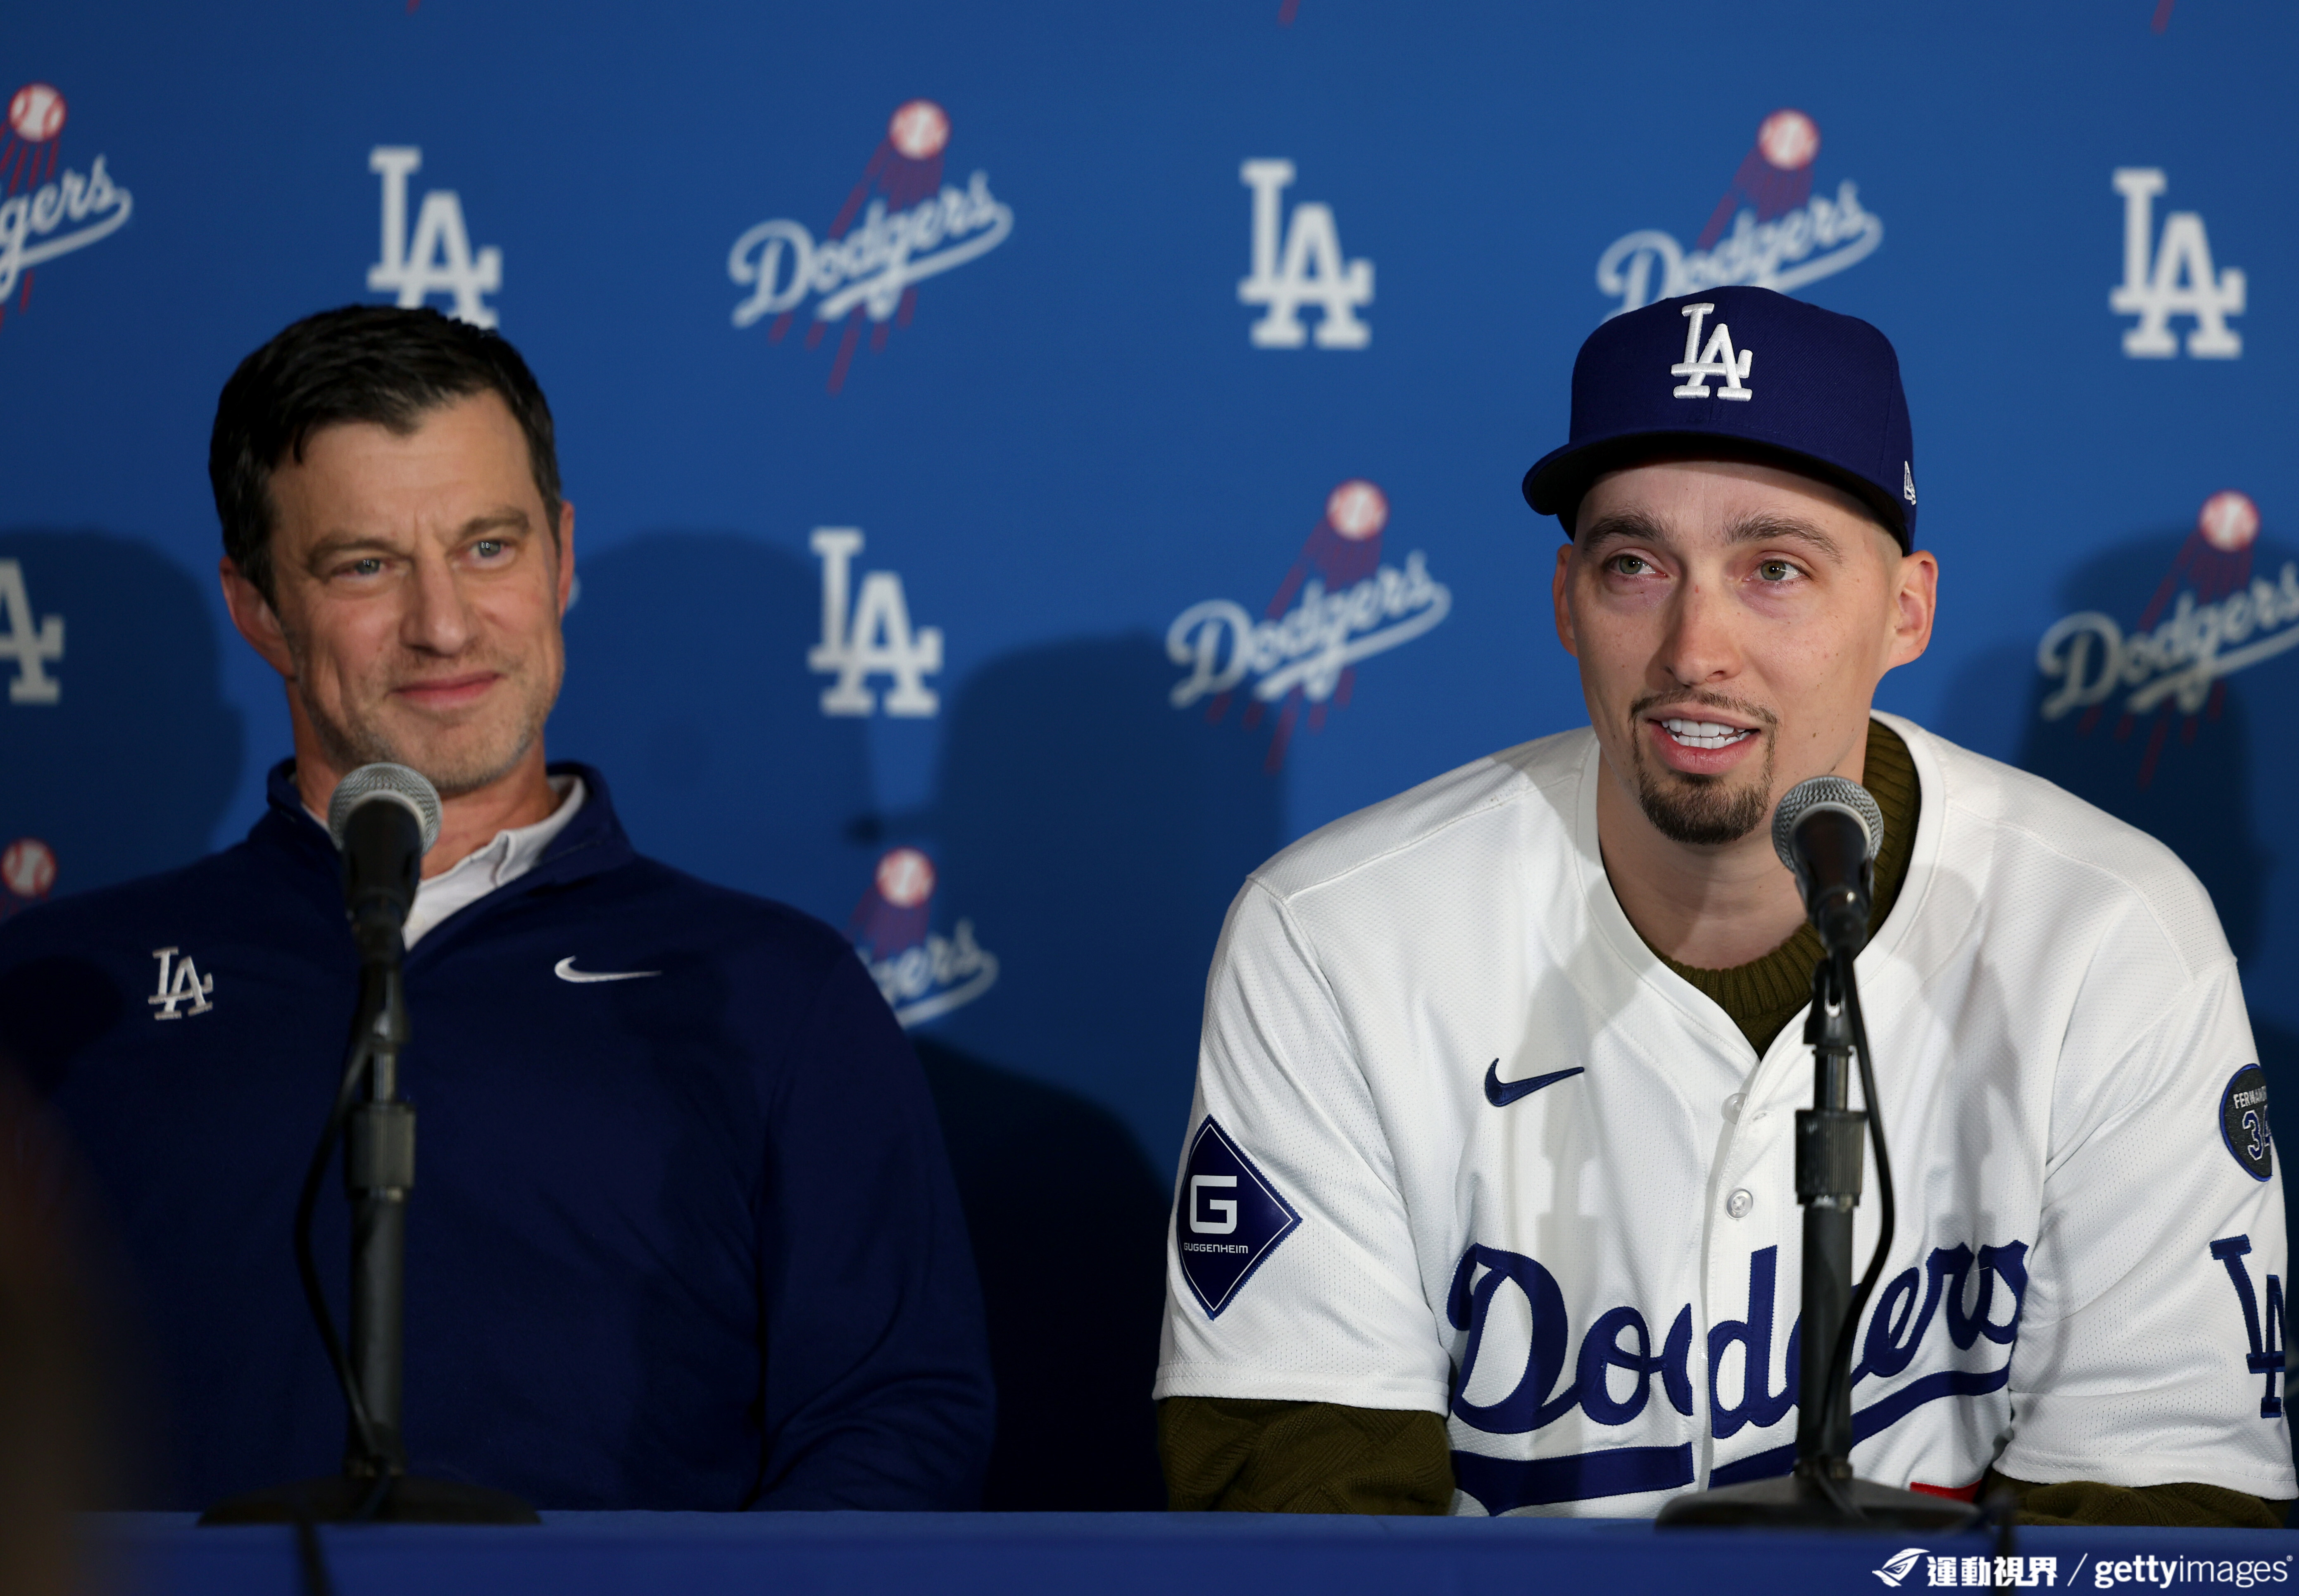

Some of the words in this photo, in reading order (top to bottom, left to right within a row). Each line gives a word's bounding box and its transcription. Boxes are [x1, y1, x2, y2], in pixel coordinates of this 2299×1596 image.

[367, 145, 502, 329] LA
[728, 169, 1014, 329] Dodgers
[1237, 158, 1376, 350] LA
[2110, 166, 2248, 359] LA
[1671, 302, 1753, 402] LA
[807, 526, 945, 718] LA
[1165, 549, 1452, 711] Dodgers
[148, 946, 213, 1020] LA
[1183, 1242, 1248, 1254] GUGGENHEIM
[1190, 1175, 1237, 1234] G
[1446, 1239, 2028, 1515] Doders
